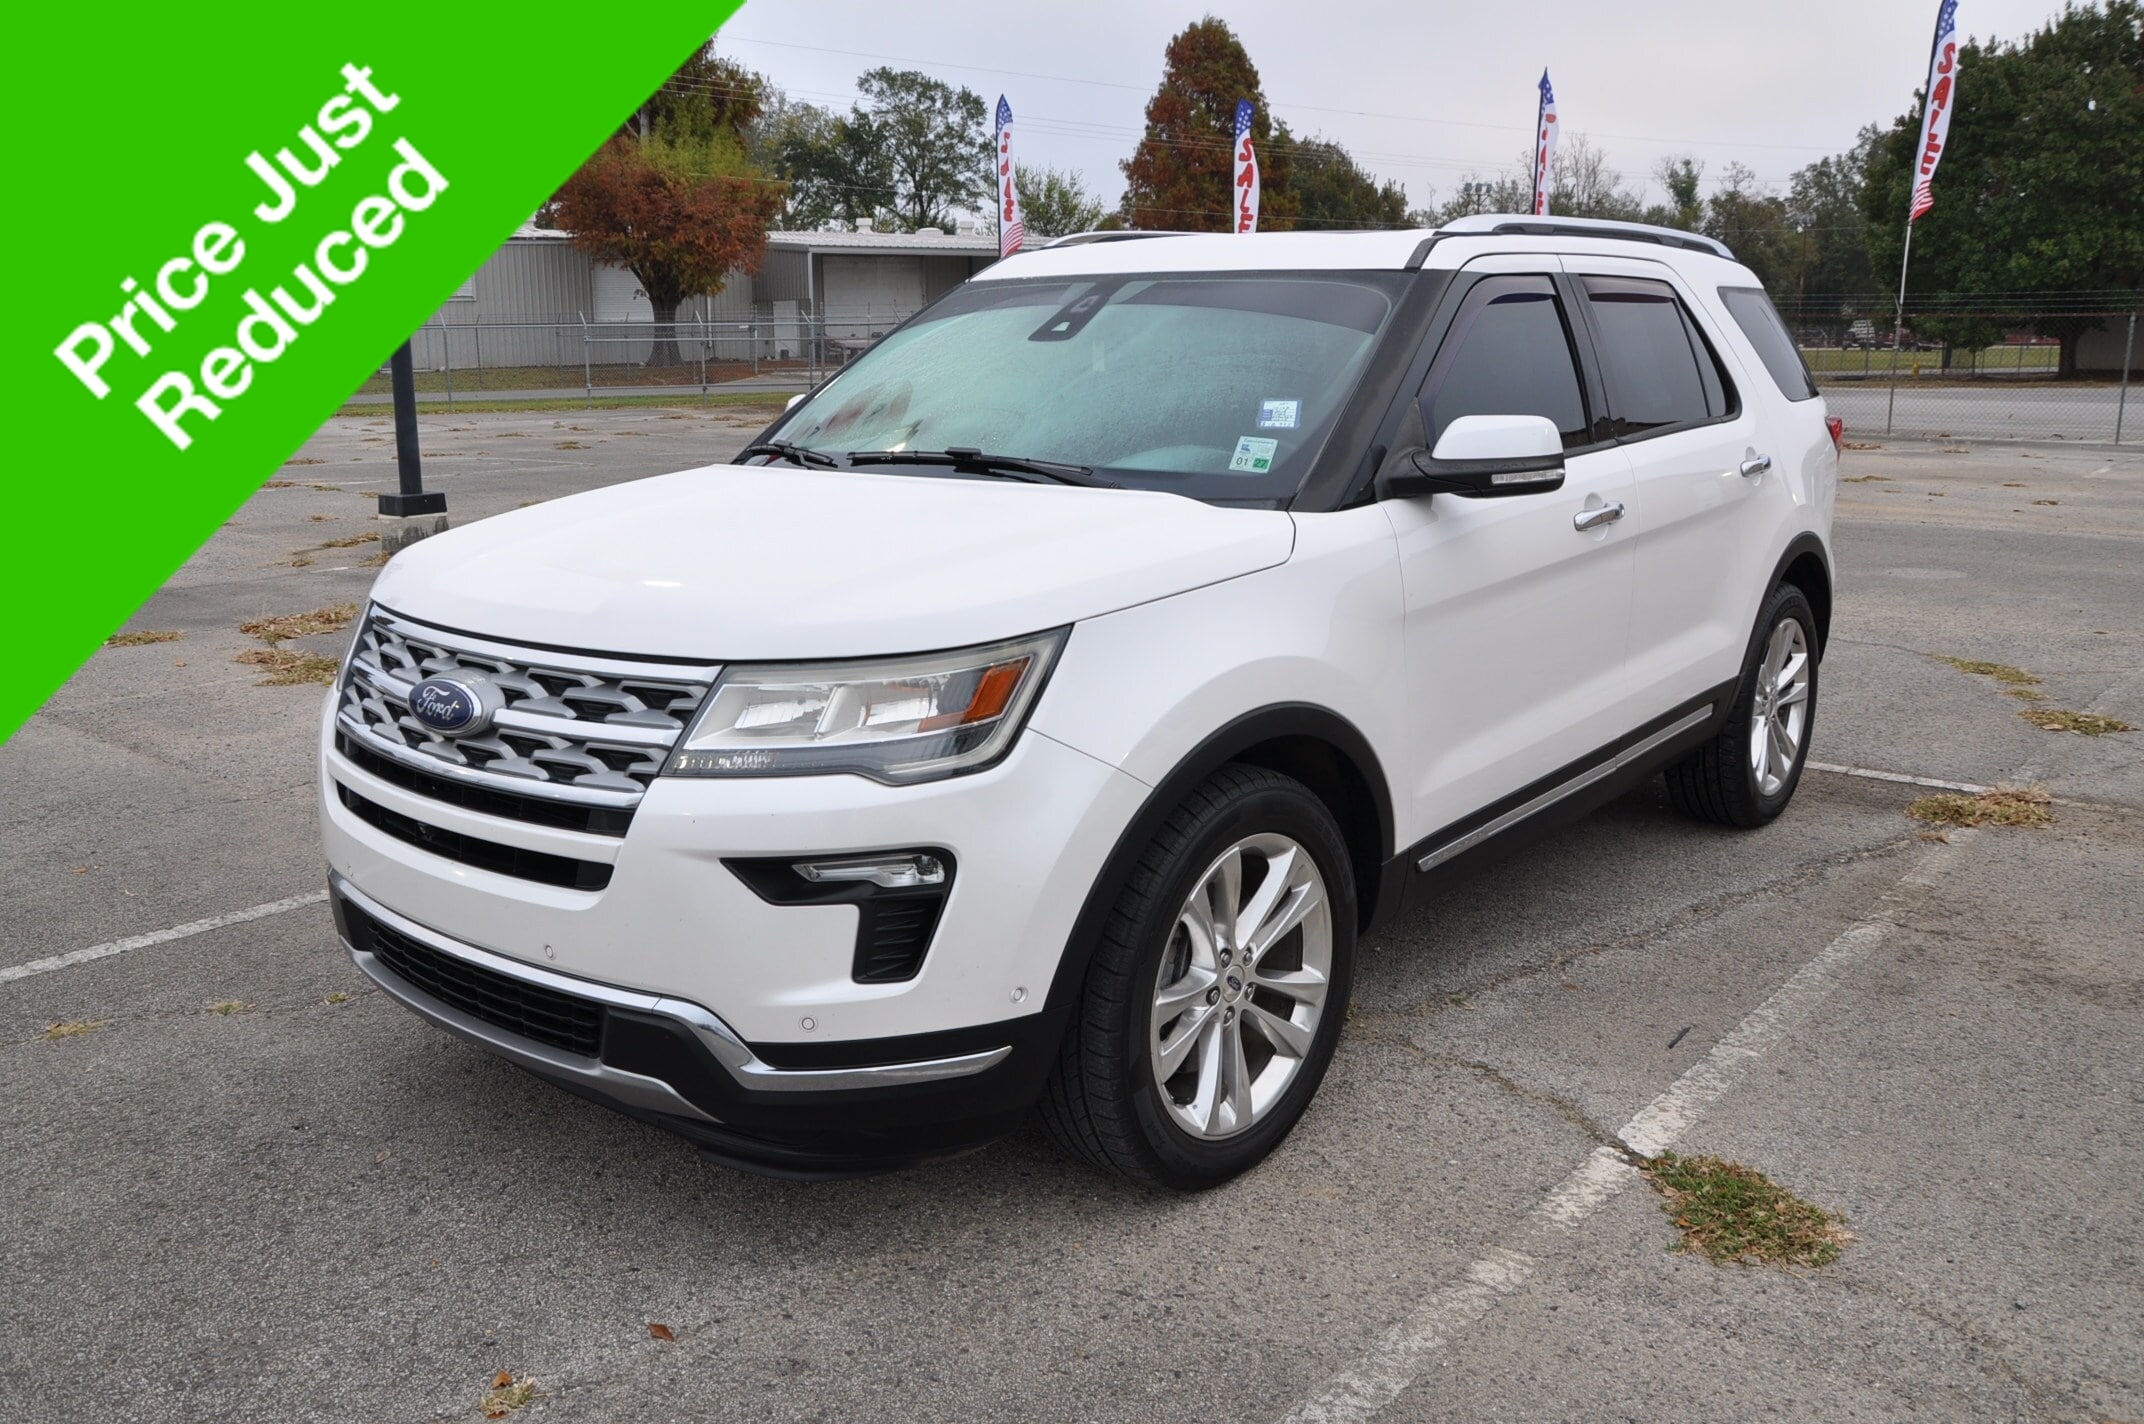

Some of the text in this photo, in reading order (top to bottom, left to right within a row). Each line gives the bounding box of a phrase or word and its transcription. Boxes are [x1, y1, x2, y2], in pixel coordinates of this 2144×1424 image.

[1920, 42, 1956, 175] SALE
[1236, 137, 1255, 233] SALE
[1235, 456, 1267, 468] 01 27
[416, 685, 460, 720] Ford
